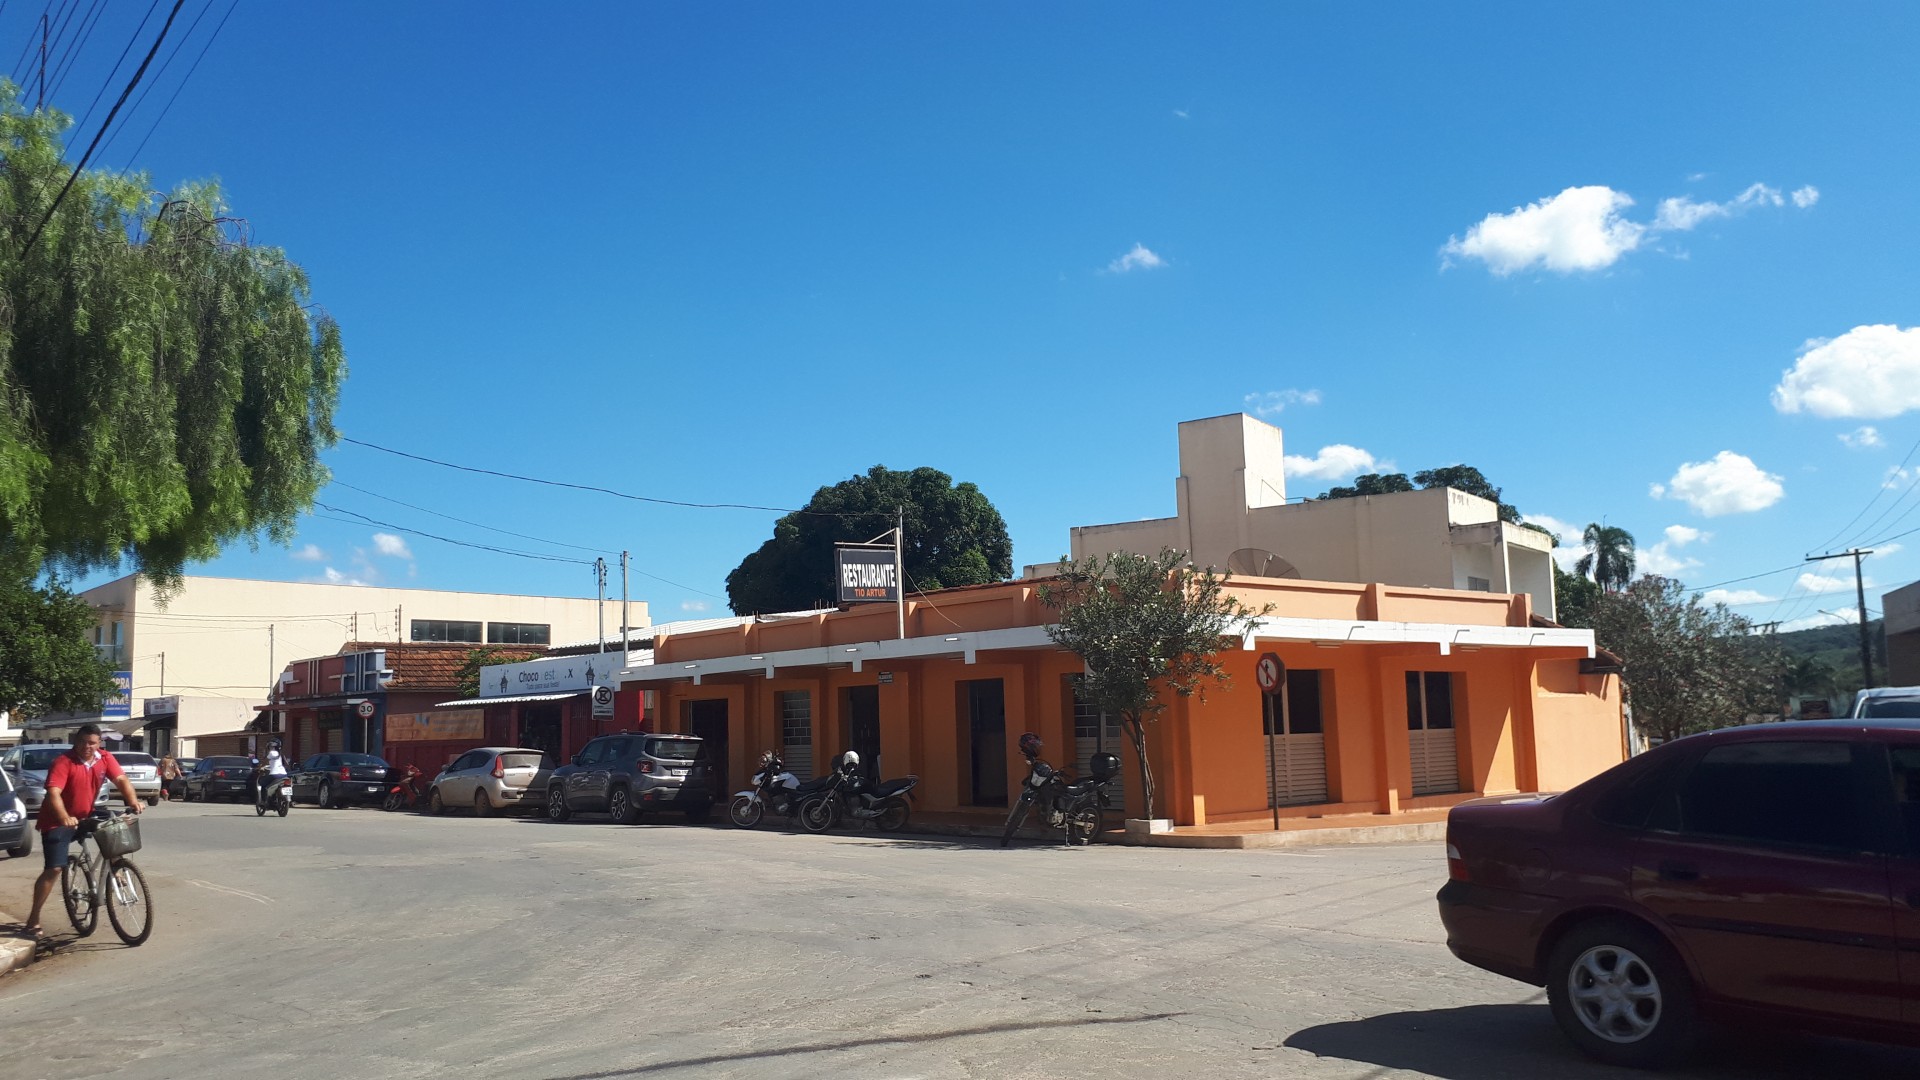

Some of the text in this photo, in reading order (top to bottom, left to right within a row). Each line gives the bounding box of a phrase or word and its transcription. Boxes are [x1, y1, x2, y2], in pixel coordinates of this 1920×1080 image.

[842, 563, 896, 587] RESTAURANTE
[855, 588, 886, 597] TIO ARTUR
[519, 671, 539, 682] Choco
